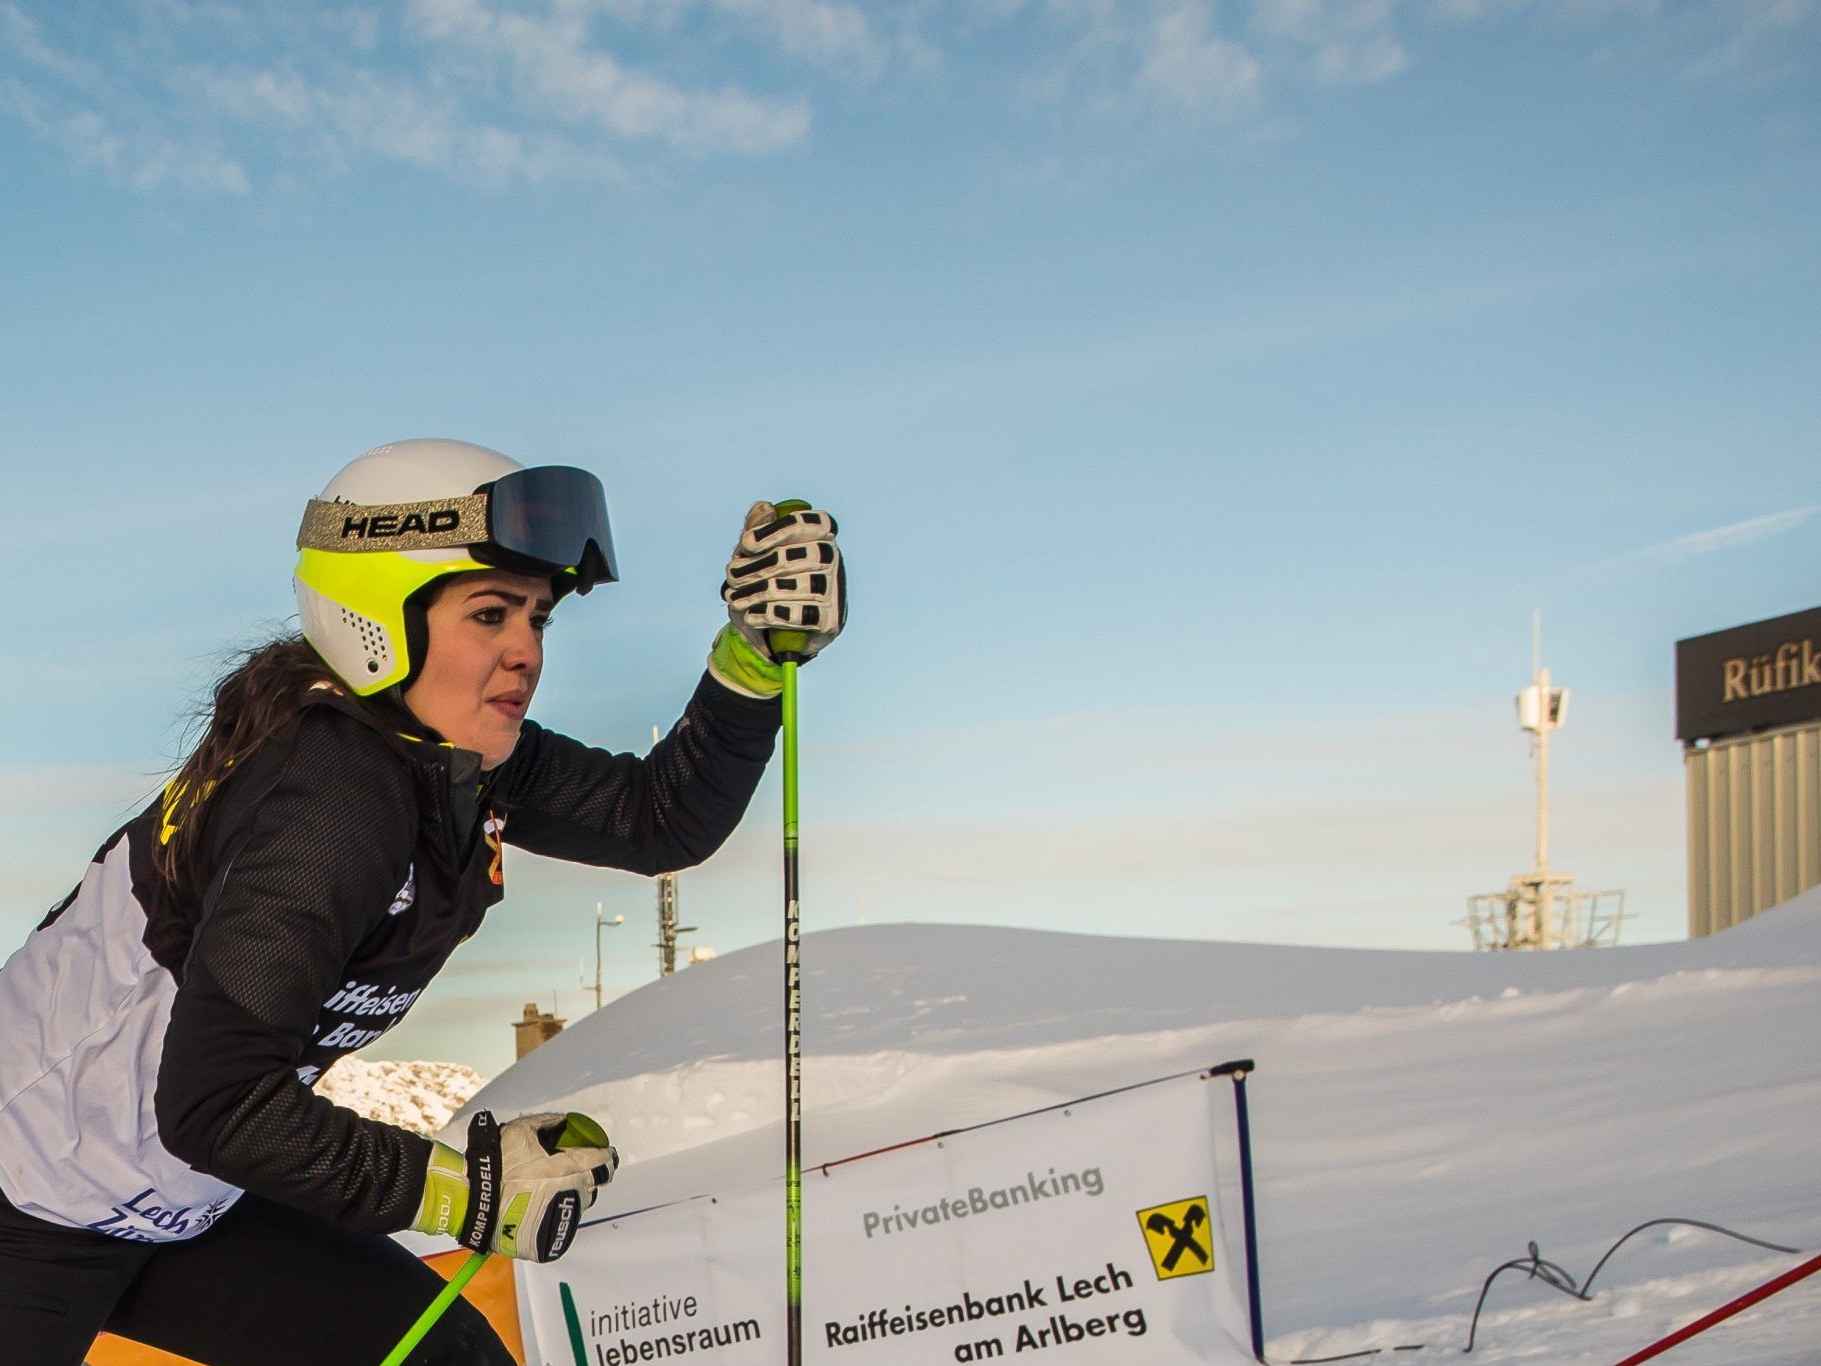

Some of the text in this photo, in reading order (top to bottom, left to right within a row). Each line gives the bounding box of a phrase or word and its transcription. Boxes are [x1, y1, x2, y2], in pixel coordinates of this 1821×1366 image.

[341, 509, 460, 538] HEAD
[323, 981, 421, 1015] iffeisen
[317, 1022, 397, 1048] Ban
[122, 1188, 194, 1234] Lech
[469, 1155, 491, 1247] KOMPERDELL
[863, 1167, 1104, 1238] PrivateBanking
[549, 1197, 575, 1257] reusch
[591, 1295, 697, 1337] initiative
[825, 1262, 1133, 1348] Raiffeisenbank Lech
[954, 1308, 1147, 1363] am Arlberg
